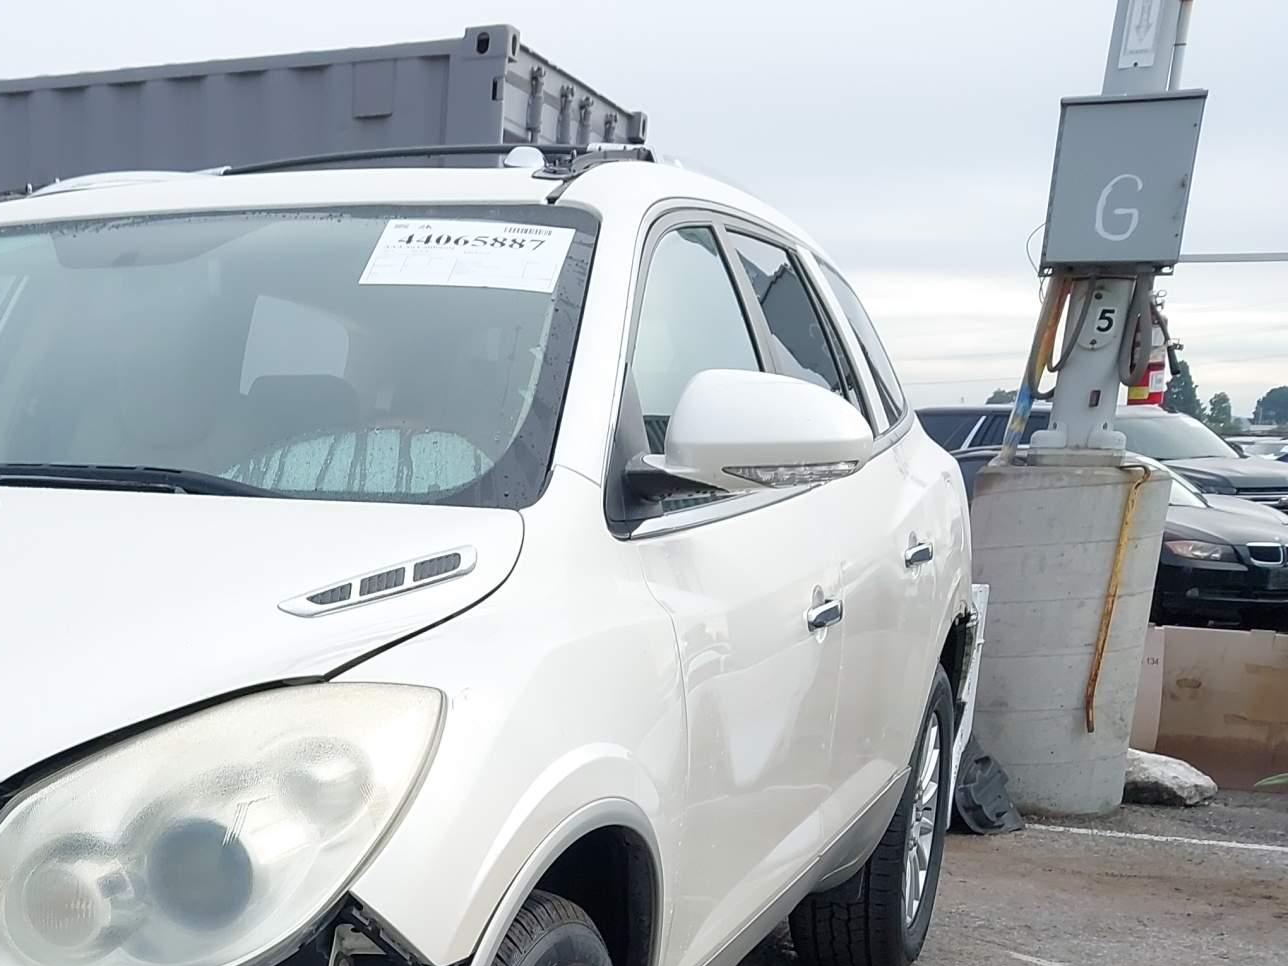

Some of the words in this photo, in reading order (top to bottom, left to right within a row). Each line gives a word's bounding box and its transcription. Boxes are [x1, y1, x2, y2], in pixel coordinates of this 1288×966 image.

[1095, 174, 1143, 241] G
[398, 233, 546, 251] 44065887
[1096, 308, 1115, 332] 5
